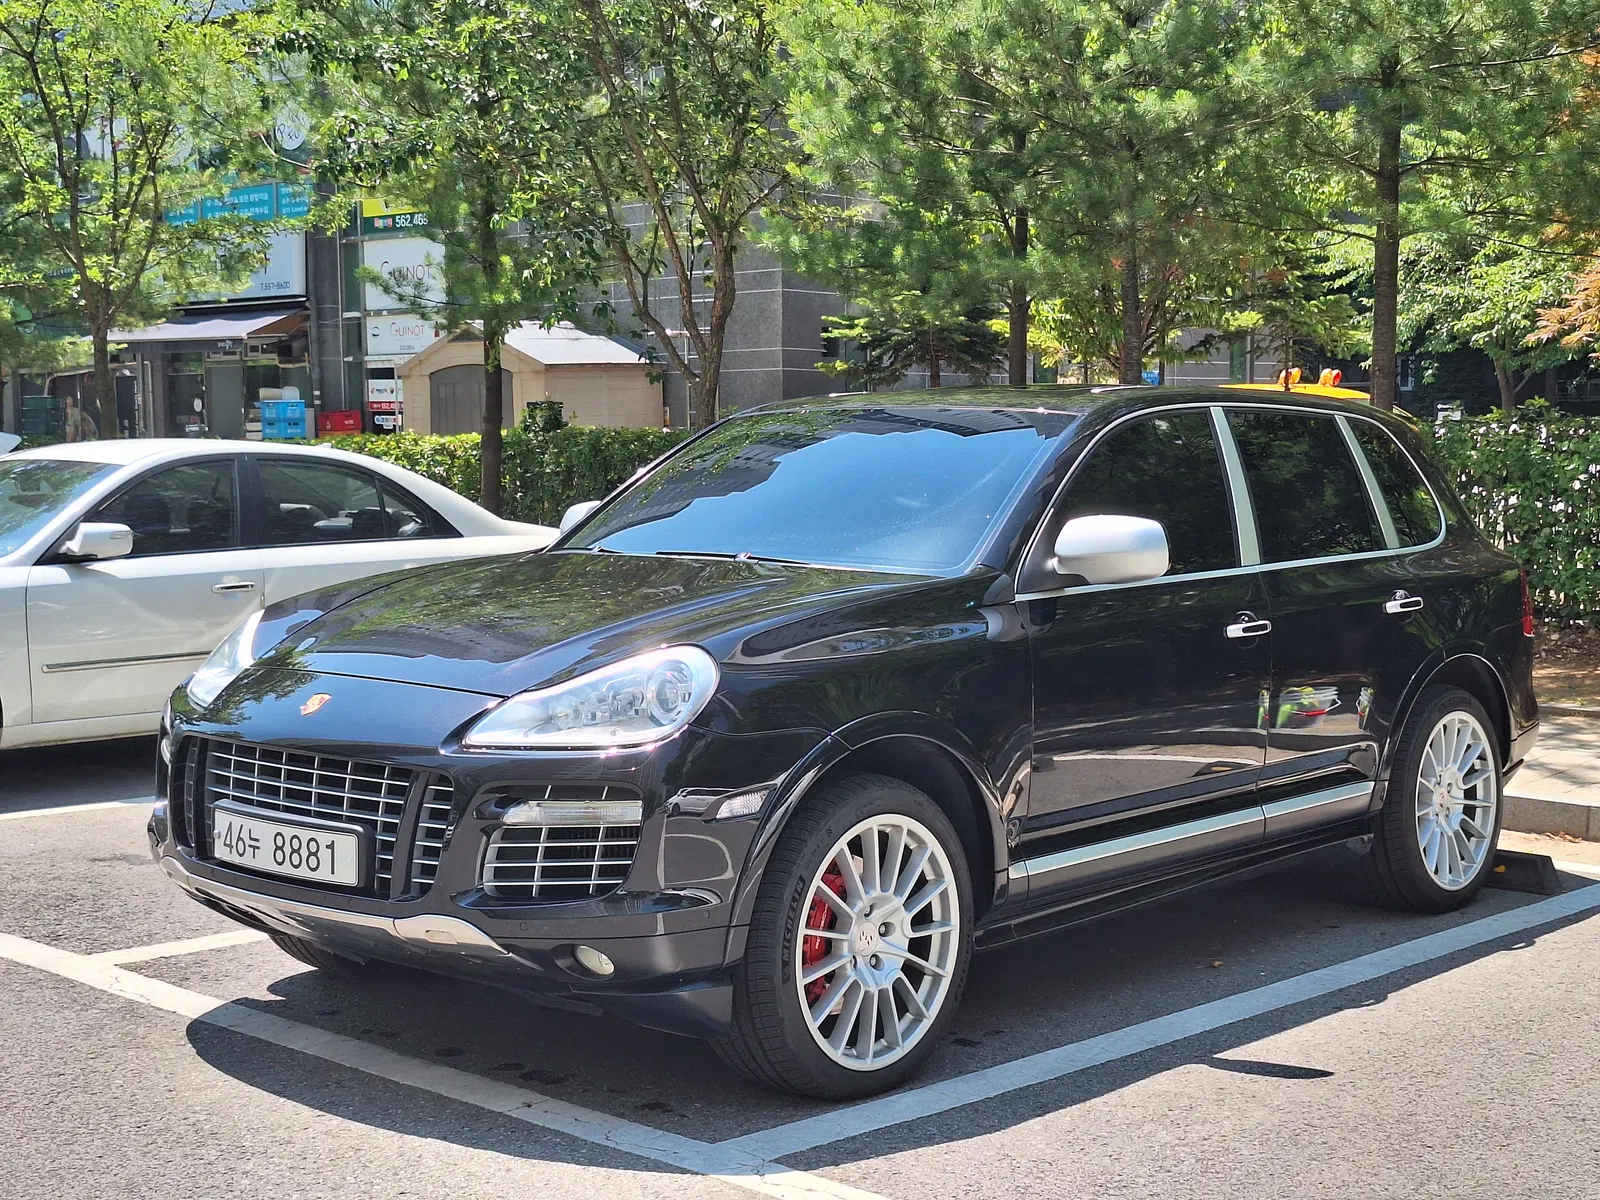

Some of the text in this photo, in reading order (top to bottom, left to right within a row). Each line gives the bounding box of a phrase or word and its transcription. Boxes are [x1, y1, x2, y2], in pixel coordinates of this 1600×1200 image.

[390, 322, 425, 337] GUINOT
[223, 821, 335, 875] 46누 8881
[783, 879, 804, 961] MICHELIN
